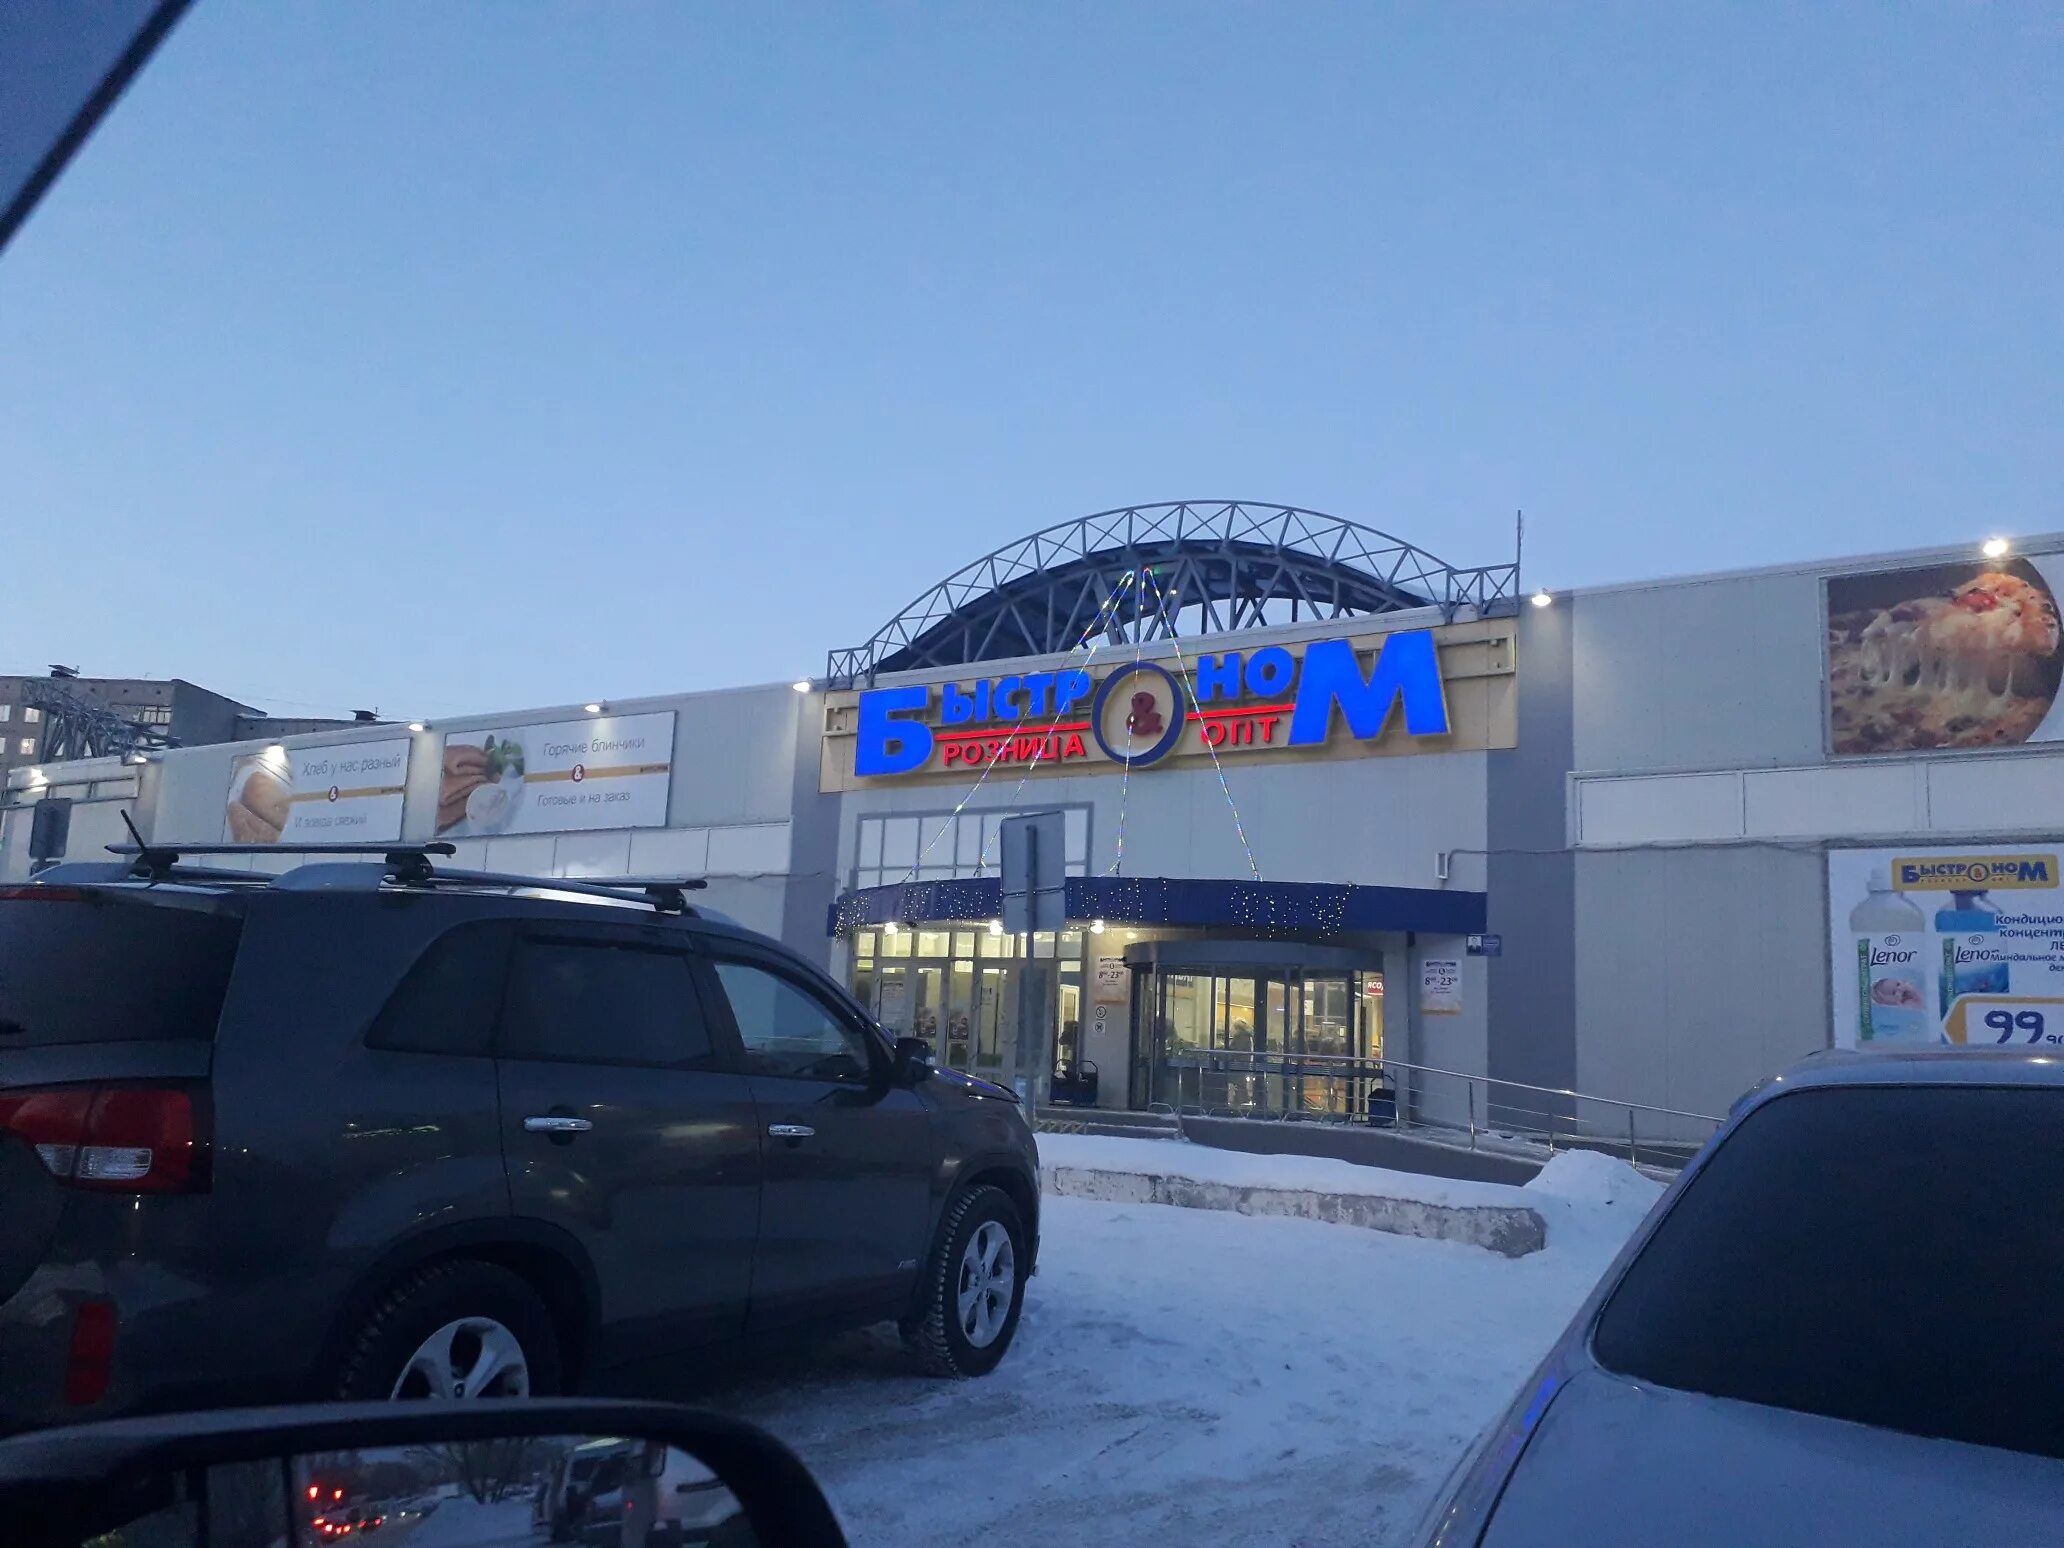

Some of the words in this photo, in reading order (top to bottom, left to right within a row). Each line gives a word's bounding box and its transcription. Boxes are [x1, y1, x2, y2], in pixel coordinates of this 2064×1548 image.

[543, 742, 588, 758] Горячие
[591, 738, 645, 753] блинчики
[943, 733, 1086, 766] РОЗНИЦА
[1201, 717, 1279, 746] ОПТ
[303, 760, 328, 776] Хлеб
[331, 762, 336, 777] у
[340, 760, 359, 773] нас
[361, 753, 401, 774] разный
[538, 793, 577, 807] Готовые
[589, 793, 601, 803] на
[604, 791, 631, 803] заказ
[2000, 929, 2064, 939] концент
[1870, 946, 1918, 967] Lenor
[1990, 952, 2057, 961] Миндальное
[1984, 1010, 2044, 1044] 99
